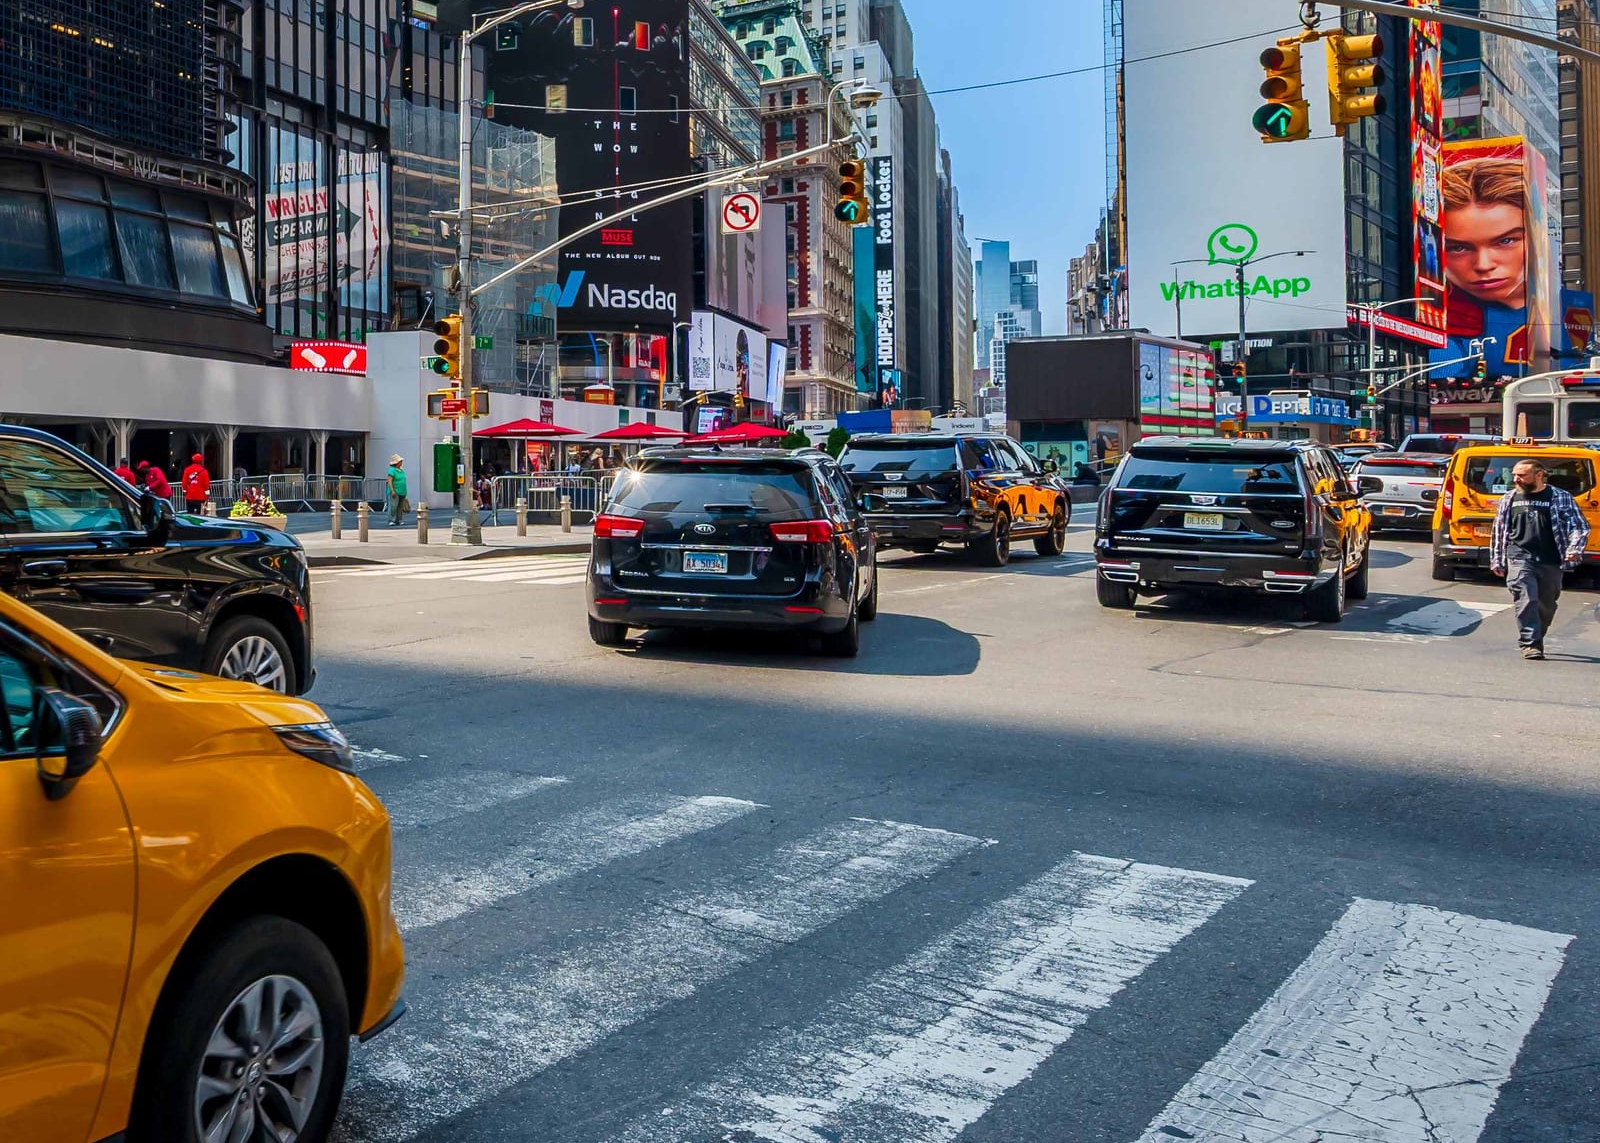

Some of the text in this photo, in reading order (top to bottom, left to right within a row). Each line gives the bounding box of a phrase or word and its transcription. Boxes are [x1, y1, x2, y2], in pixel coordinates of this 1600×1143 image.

[594, 120, 638, 131] THE
[594, 143, 638, 154] WOW
[875, 159, 892, 244] Foot Locker
[602, 232, 633, 242] MUSE
[877, 269, 892, 304] HERE
[1160, 272, 1311, 303] WhatsApp
[587, 283, 677, 318] Nasdaq
[878, 318, 893, 365] HOOPS
[1245, 339, 1273, 348] DITION
[699, 525, 712, 533] KIA
[686, 559, 725, 569] AX 50341
